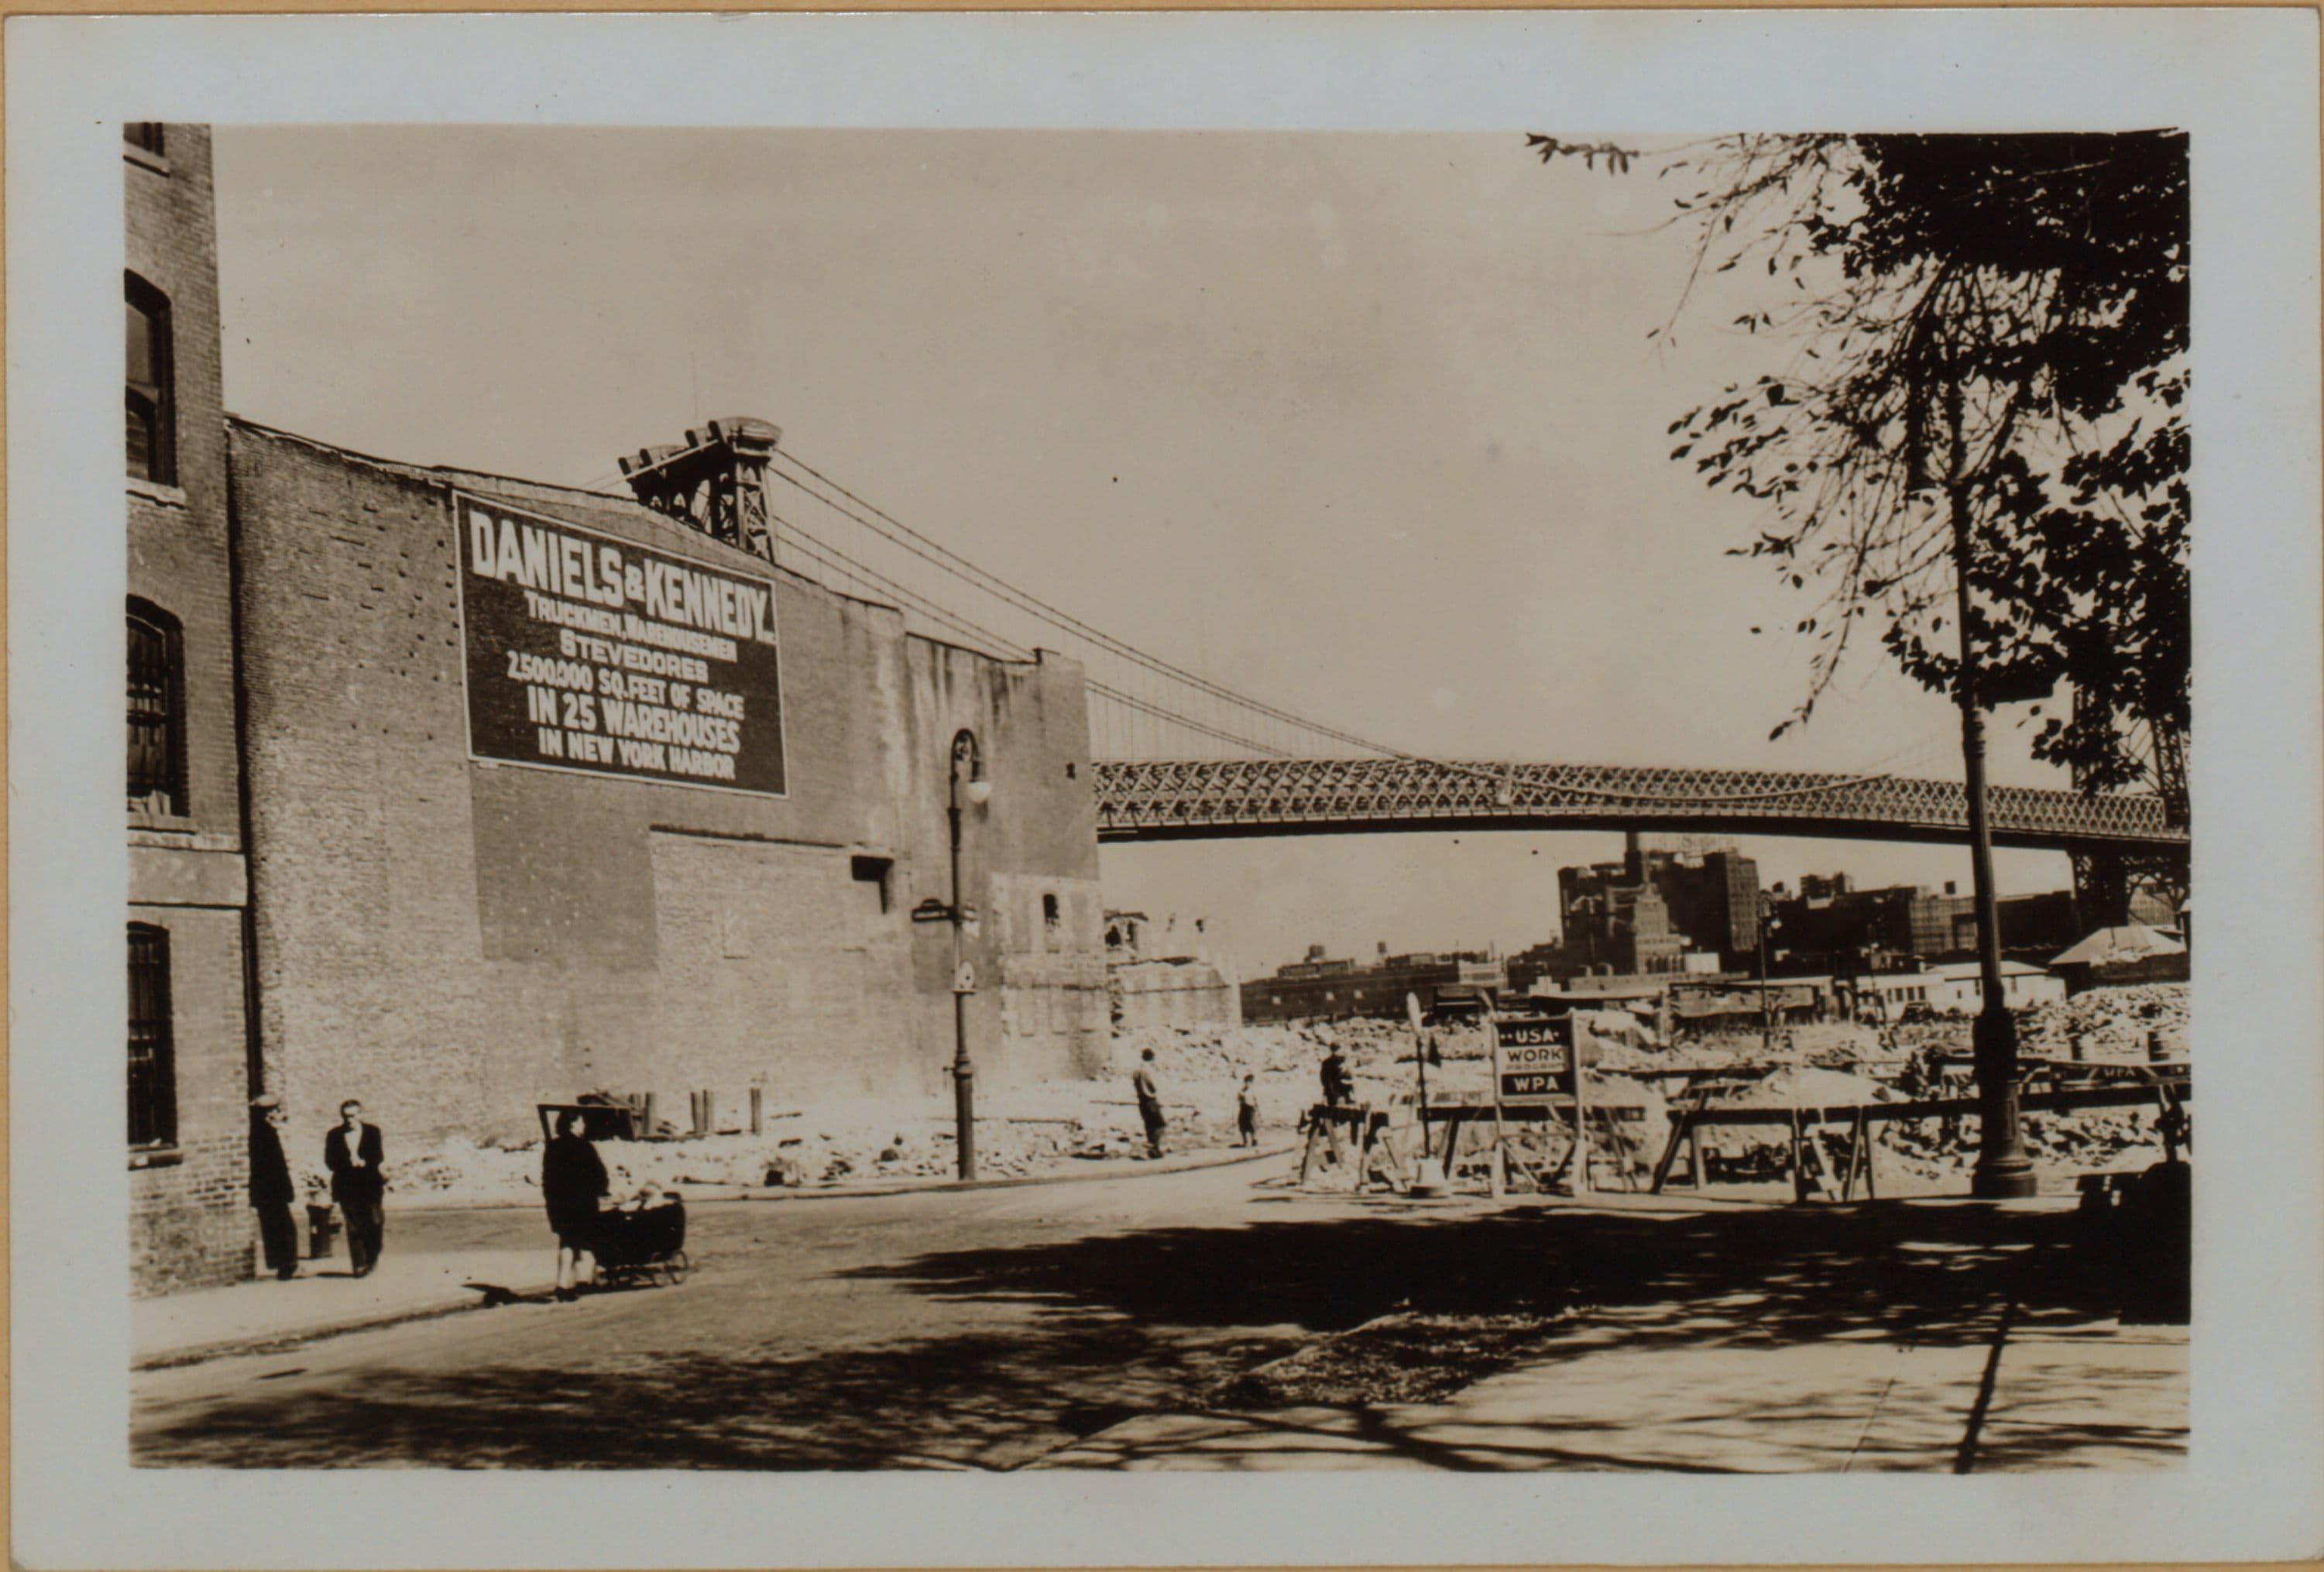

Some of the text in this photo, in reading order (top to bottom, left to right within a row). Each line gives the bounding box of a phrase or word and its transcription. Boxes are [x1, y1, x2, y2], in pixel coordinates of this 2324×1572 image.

[469, 510, 768, 642] DANIELS & KENNEDY
[560, 629, 709, 685] STEVEDORES
[527, 685, 741, 755] IN 25 WAREHOUSES
[629, 673, 667, 705] FEET
[671, 682, 692, 710] OF
[696, 686, 745, 721] SPACE
[538, 727, 736, 781] IN NEW YORK HARBOR
[1507, 1049, 1562, 1062] WORK
[1516, 1028, 1554, 1043] USA
[1514, 1076, 1559, 1091] WPA
